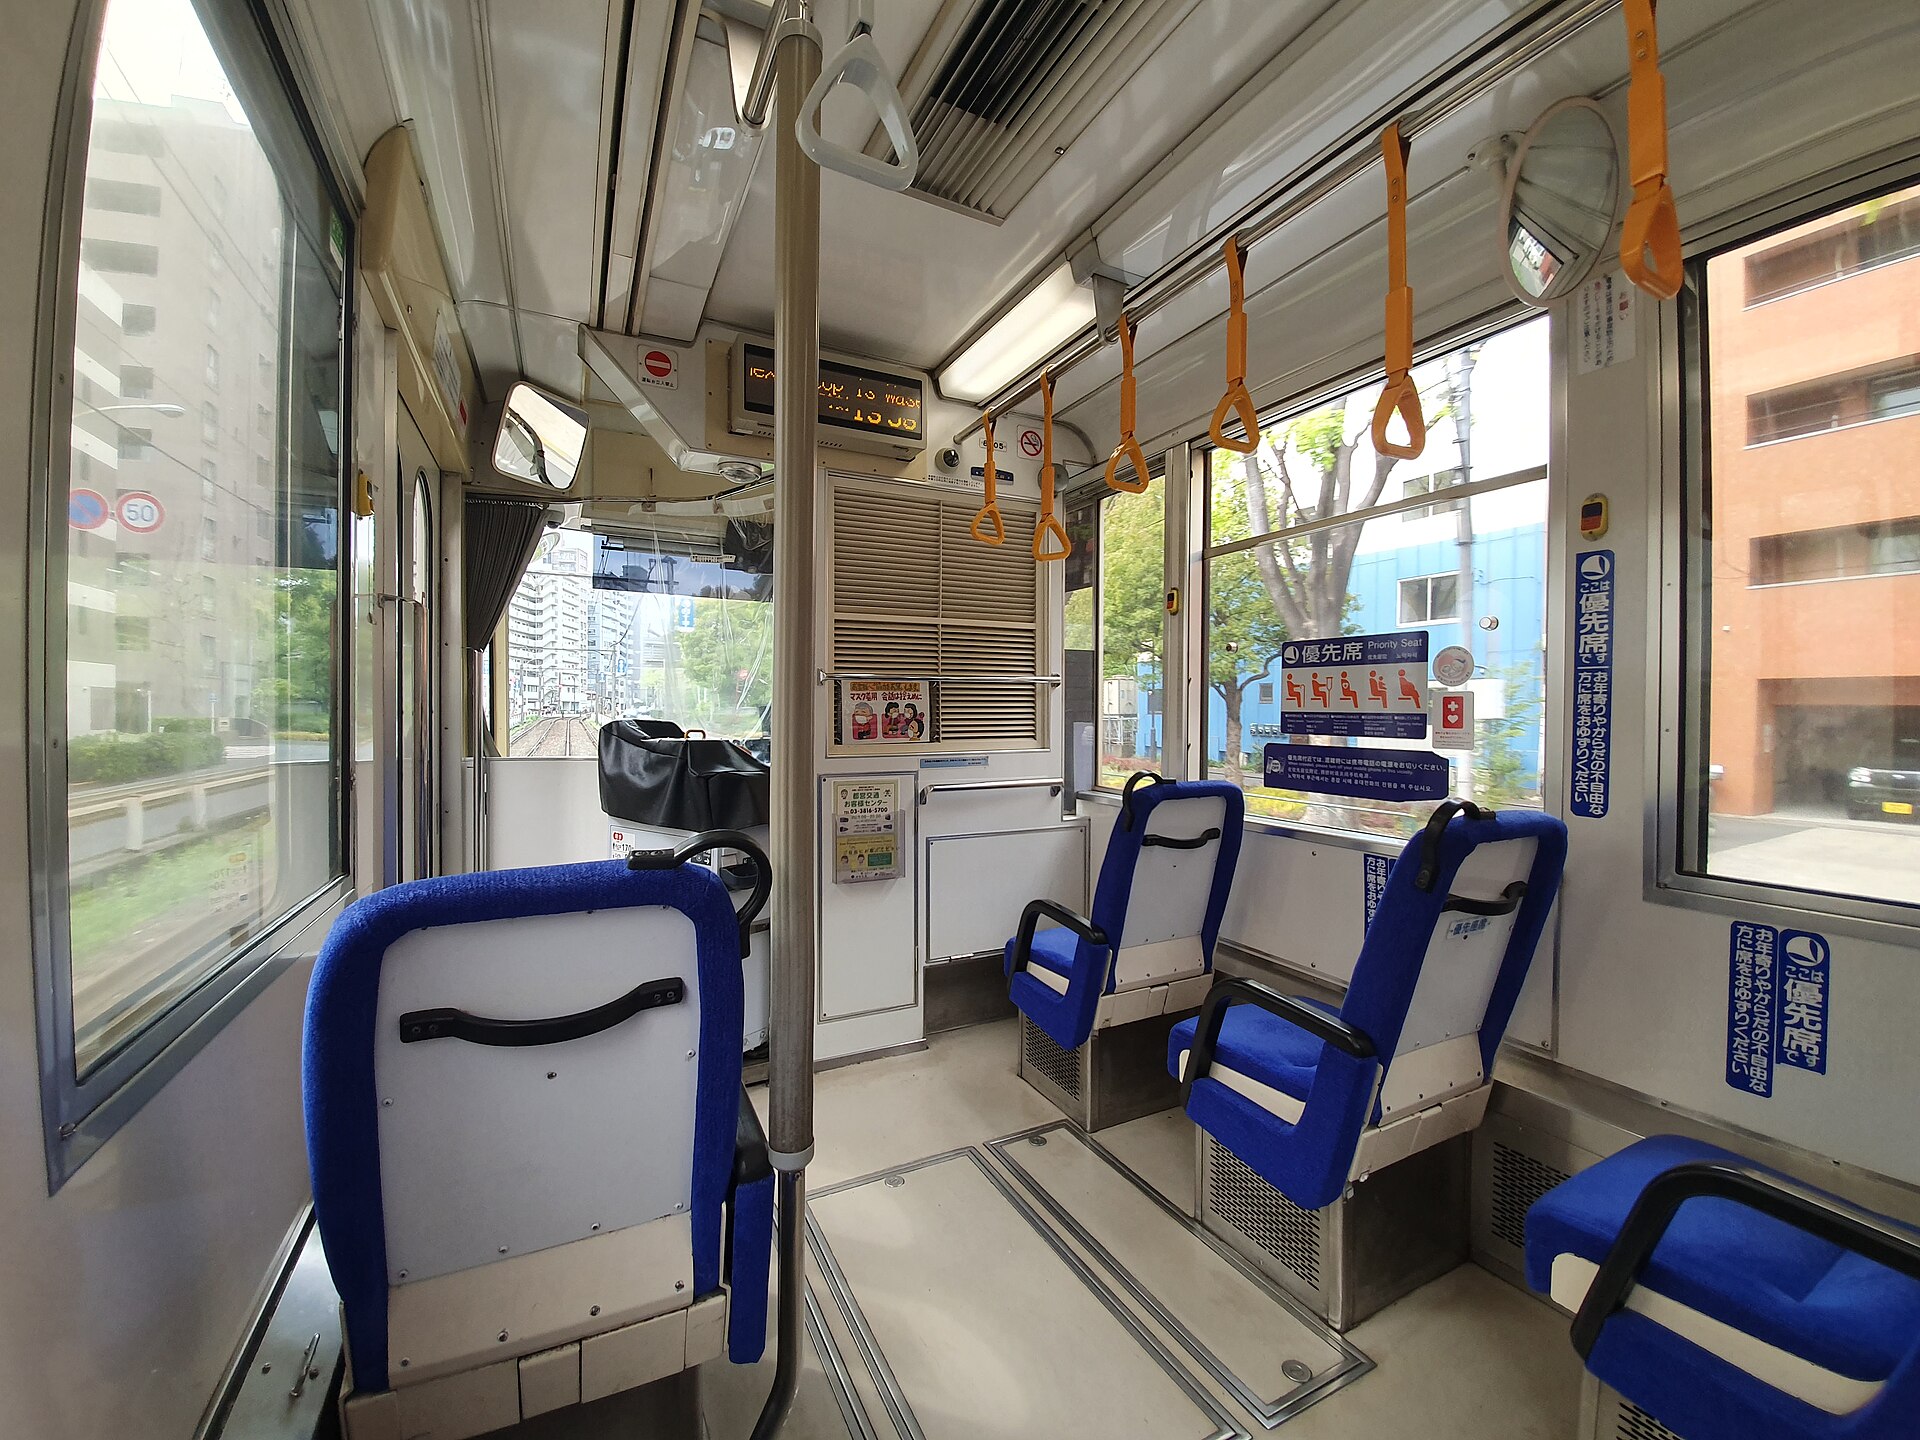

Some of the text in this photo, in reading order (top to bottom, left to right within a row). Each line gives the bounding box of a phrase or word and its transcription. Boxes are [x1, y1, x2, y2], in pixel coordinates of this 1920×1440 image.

[983, 440, 1004, 450] 805
[126, 503, 154, 522] 50
[1579, 580, 1610, 593] ここは
[1579, 592, 1610, 653] 優先席
[1368, 638, 1423, 650] Priority Seat
[1302, 642, 1364, 664] 優先席
[1580, 653, 1608, 664] です
[853, 791, 880, 799] 都営交通
[844, 799, 888, 808] お客様センター
[1785, 965, 1825, 983] ここは
[1782, 979, 1823, 1054] 優先席
[1786, 1050, 1821, 1067] です
